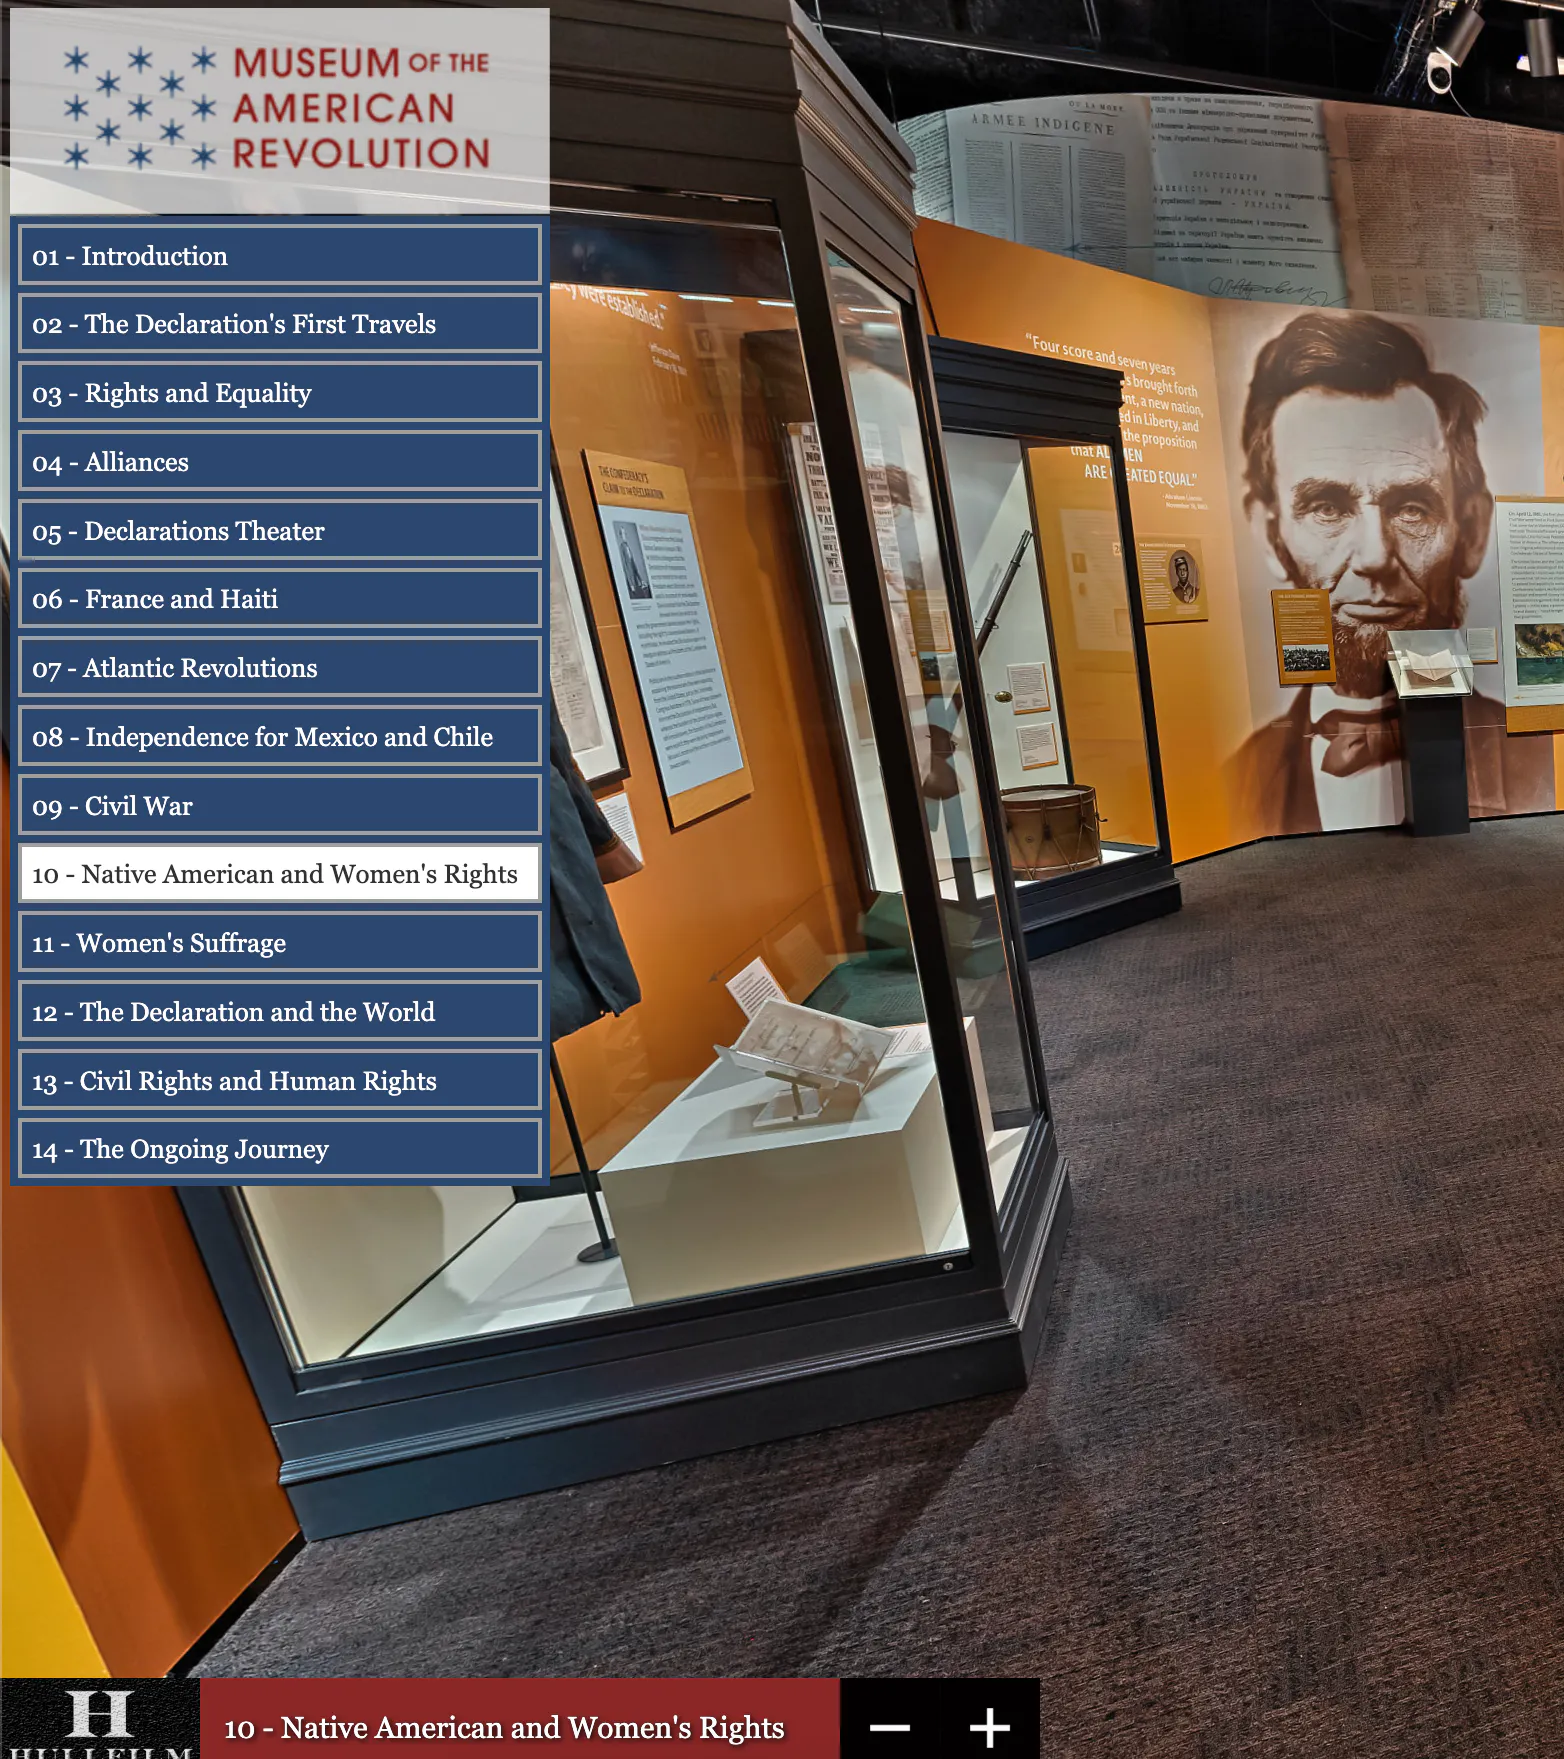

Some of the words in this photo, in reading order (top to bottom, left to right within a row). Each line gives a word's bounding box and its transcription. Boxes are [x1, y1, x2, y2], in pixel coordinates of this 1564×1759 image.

[1062, 344, 1094, 360] score
[1095, 350, 1116, 365] and
[1117, 355, 1148, 371] seven
[1149, 361, 1176, 376] years
[1132, 374, 1173, 396] brought
[1173, 380, 1198, 398] forth
[1148, 398, 1170, 411] new
[1171, 403, 1204, 418] nation,
[1132, 413, 1142, 425] in
[1144, 412, 1181, 433] Liberty,
[1182, 421, 1199, 432] and
[1123, 430, 1140, 443] the
[1142, 433, 1198, 450] proposition
[1095, 445, 1110, 459] AL
[1084, 464, 1107, 479] ARE
[1109, 465, 1157, 484] EATED
